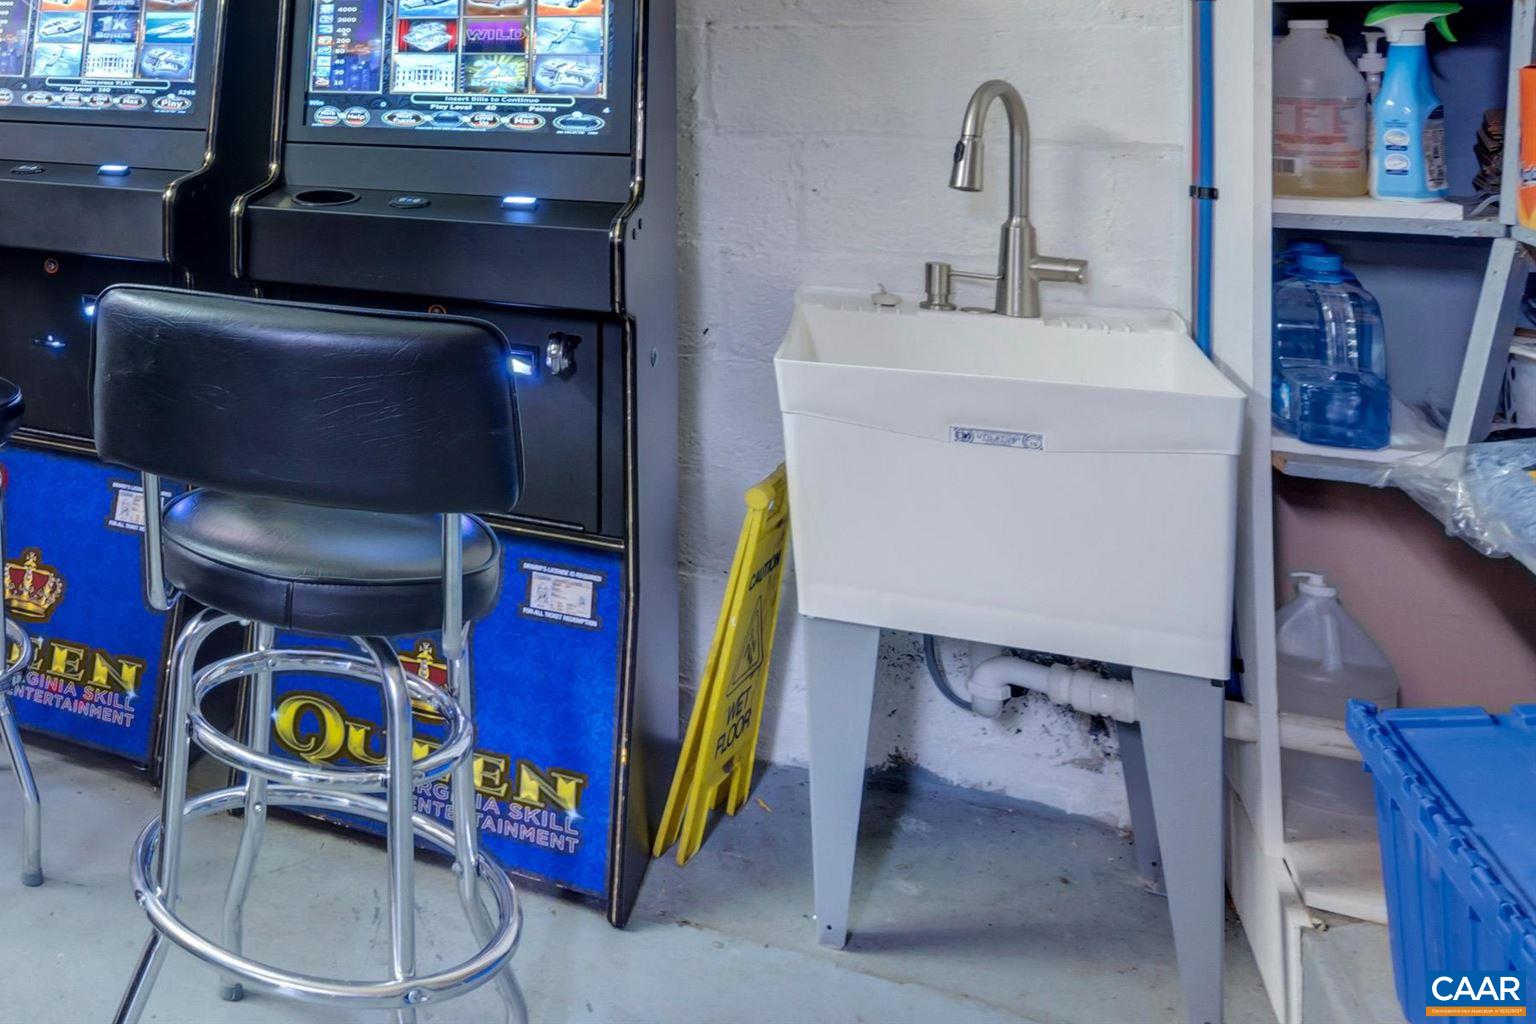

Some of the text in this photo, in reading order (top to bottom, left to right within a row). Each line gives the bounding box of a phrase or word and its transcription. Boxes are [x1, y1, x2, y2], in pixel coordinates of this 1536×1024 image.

[466, 27, 528, 41] WILD
[161, 99, 183, 108] Play
[750, 549, 782, 592] CAUTION
[83, 685, 135, 712] SKILL
[727, 685, 752, 726] WET
[714, 709, 752, 761] FLOOR
[413, 795, 580, 854] ENTETAINMENT
[508, 801, 579, 836] SKILL
